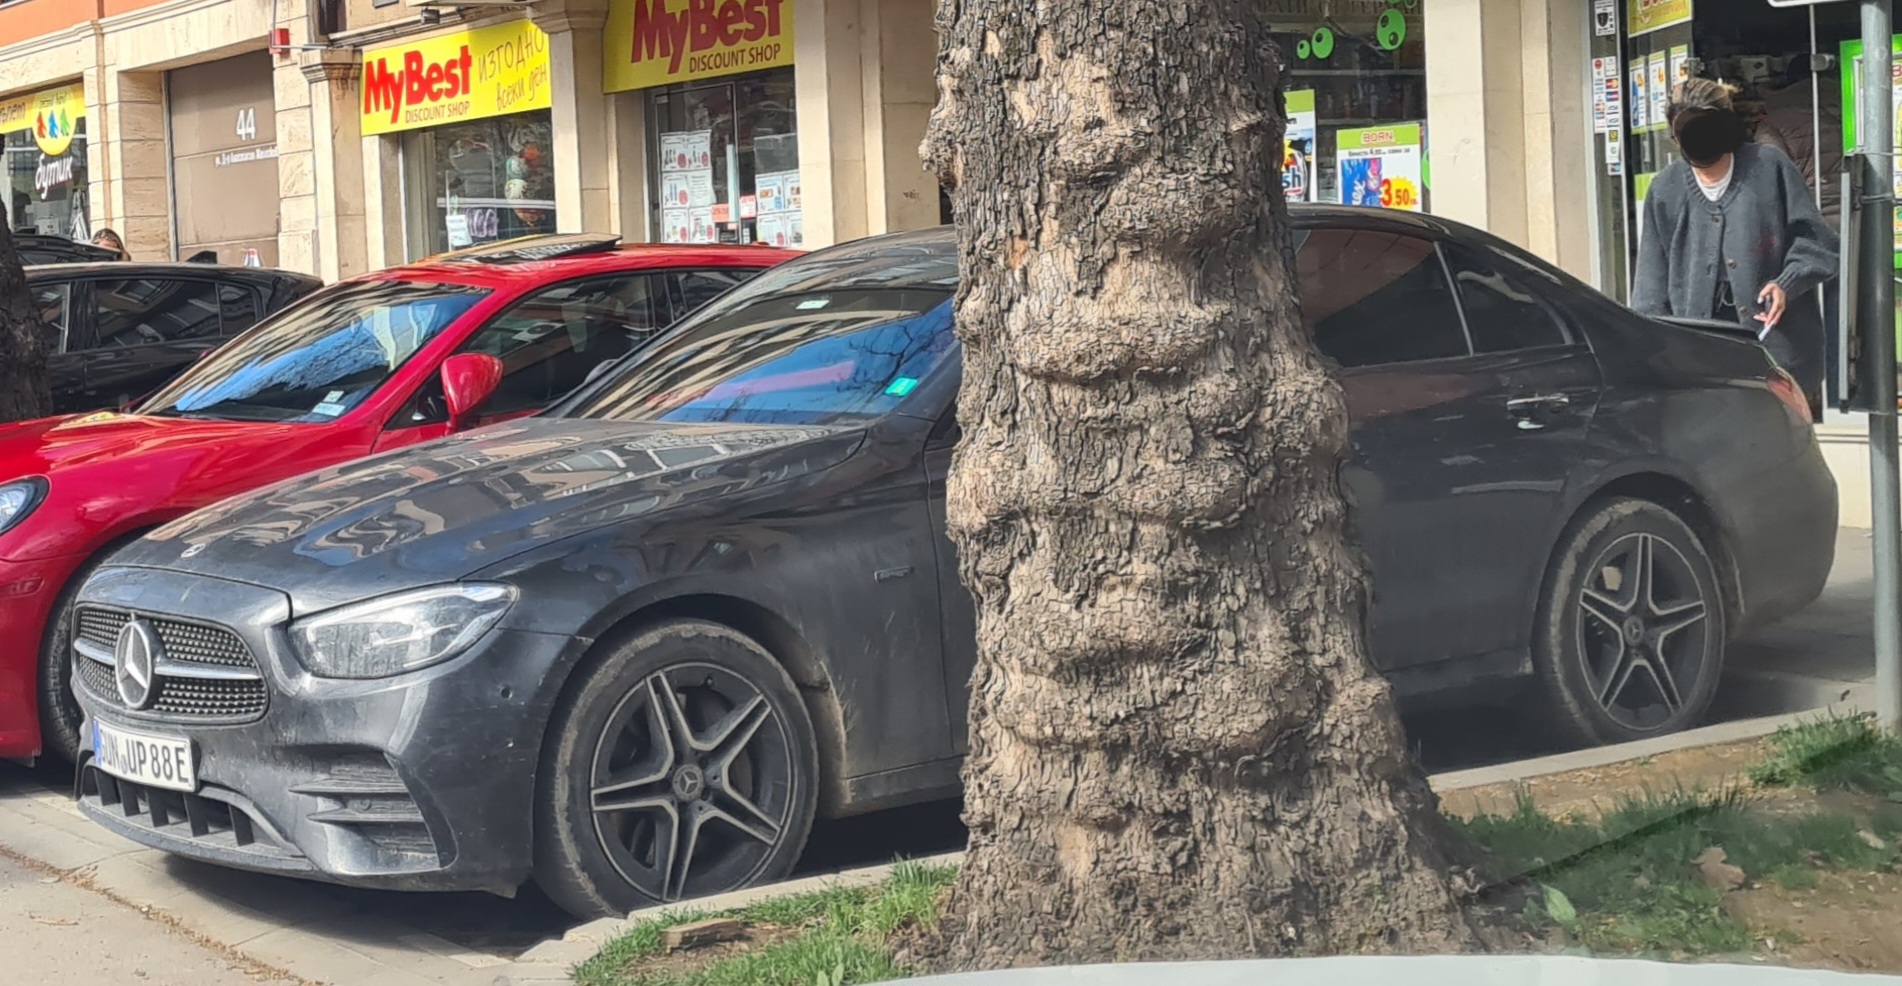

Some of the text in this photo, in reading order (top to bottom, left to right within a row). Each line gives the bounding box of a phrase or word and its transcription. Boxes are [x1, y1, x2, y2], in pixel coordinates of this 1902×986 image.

[478, 27, 545, 84] ИЗГОДНО
[631, 0, 784, 75] MyBest
[689, 43, 781, 73] DISCOUNT SHOP
[364, 45, 472, 124] MyBest
[236, 107, 255, 141] 44
[405, 101, 470, 123] DISCOUNT SHOP
[1363, 132, 1394, 143] BORN
[35, 153, 73, 200] бутик
